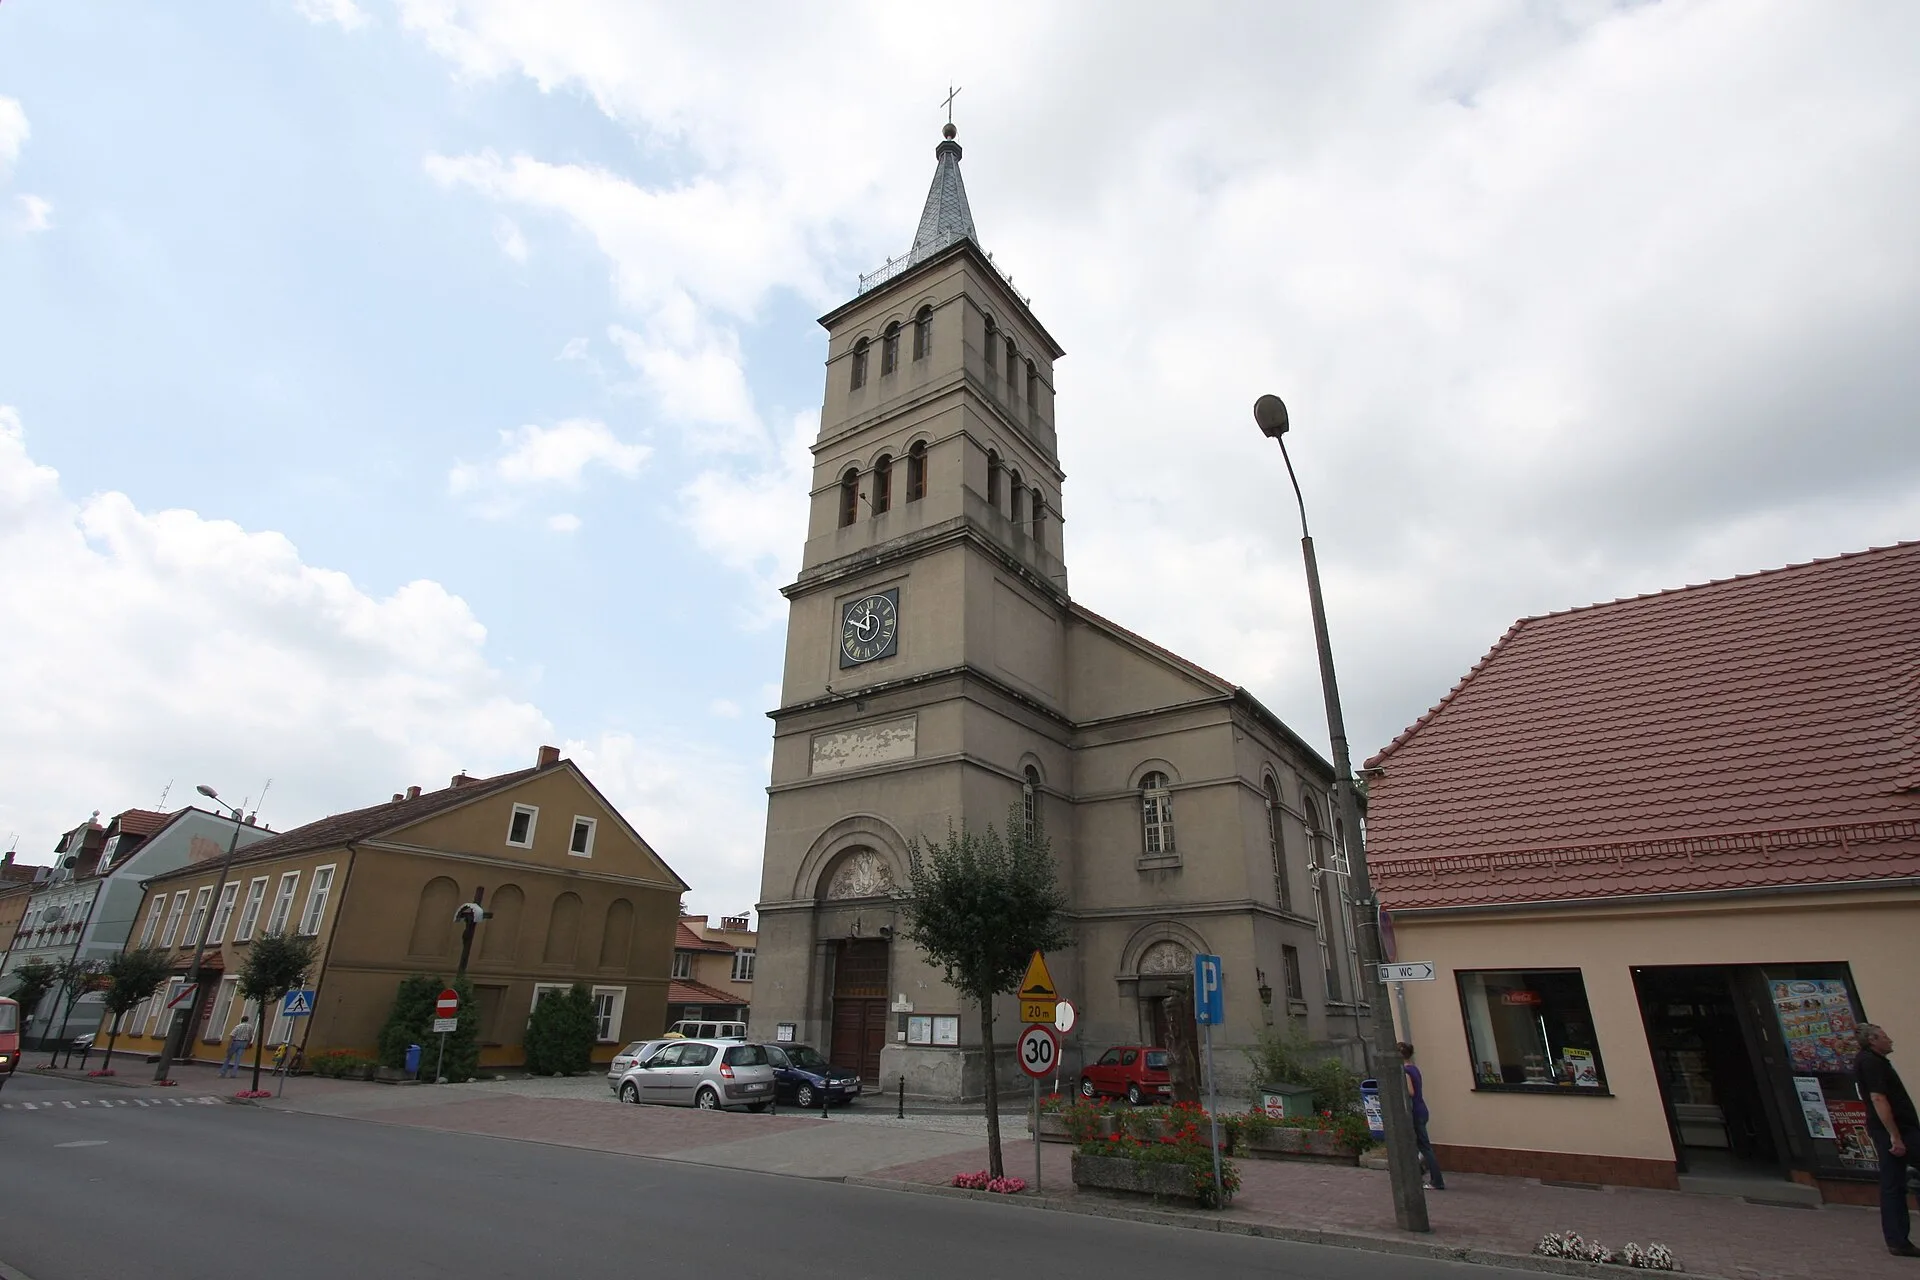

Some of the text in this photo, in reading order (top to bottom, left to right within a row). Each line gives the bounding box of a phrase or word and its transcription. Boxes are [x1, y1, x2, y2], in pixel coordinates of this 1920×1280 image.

[1201, 960, 1218, 1003] P
[1398, 966, 1413, 977] WC
[1028, 1005, 1041, 1018] 20
[1025, 1037, 1052, 1064] 30
